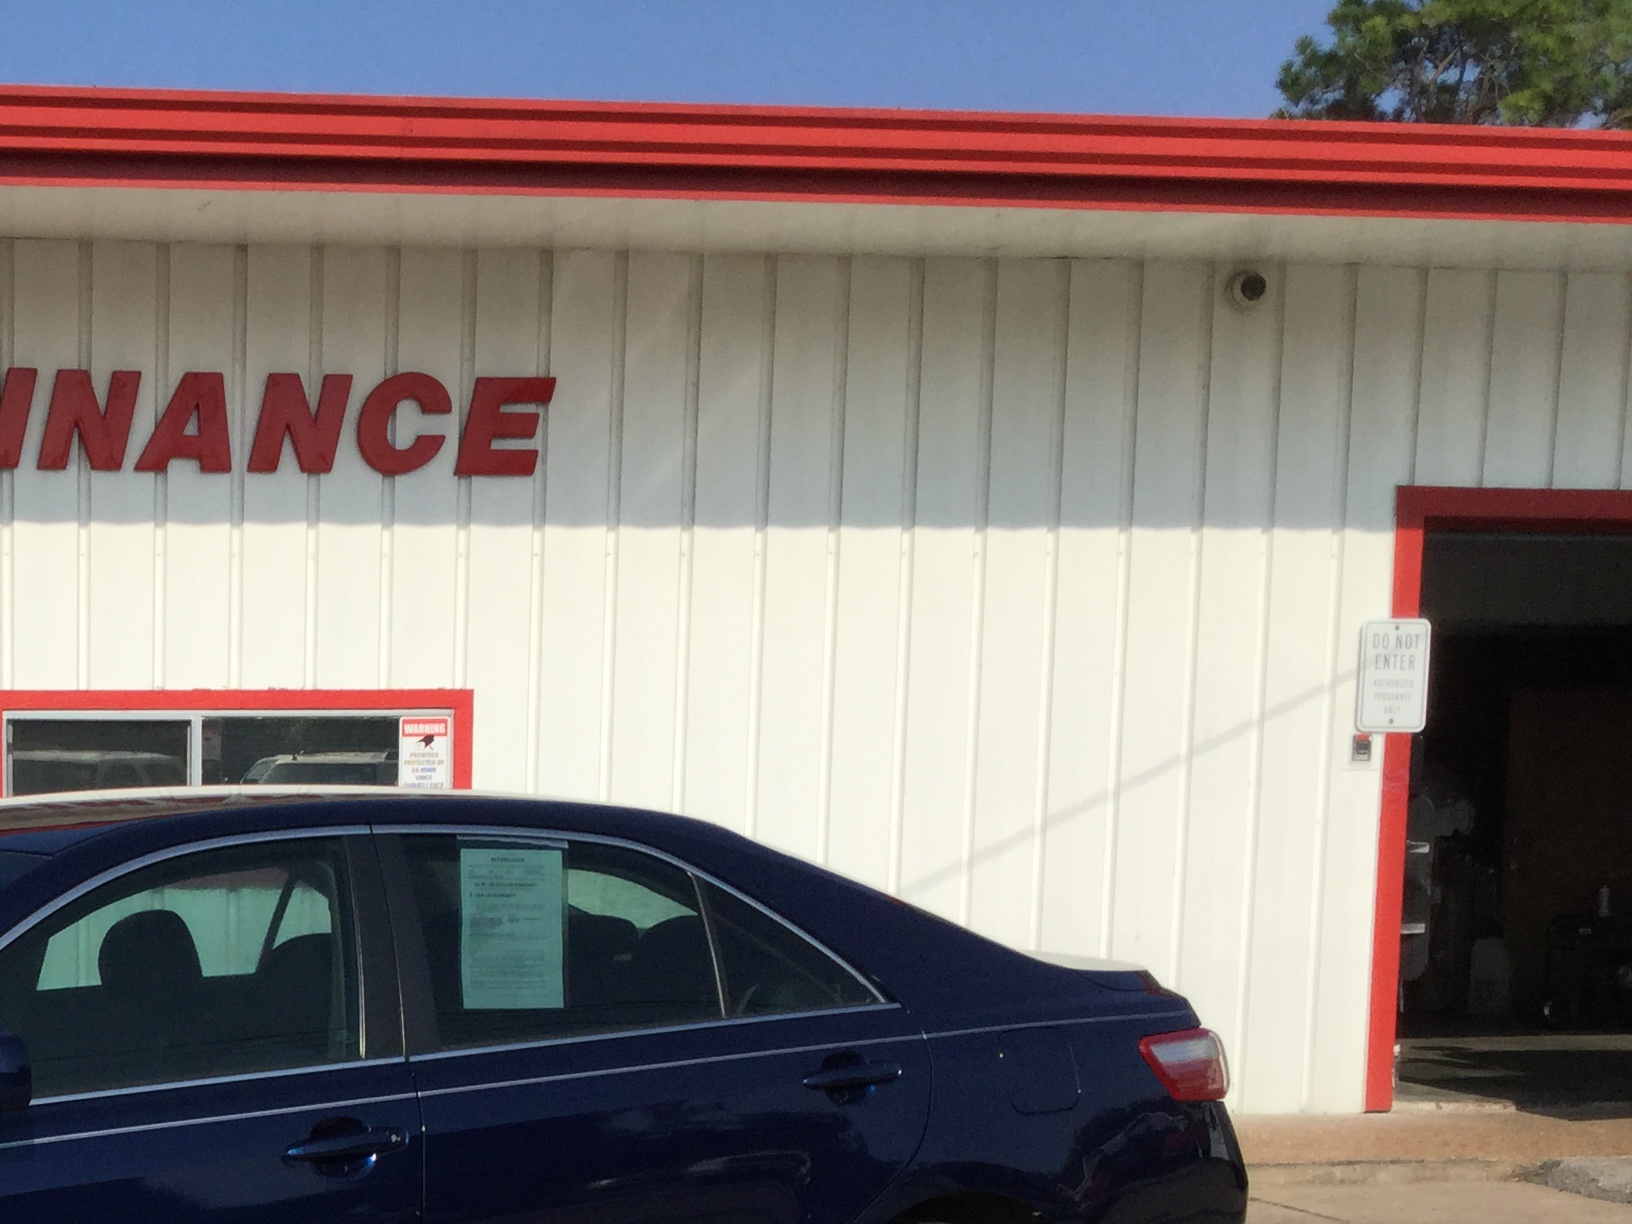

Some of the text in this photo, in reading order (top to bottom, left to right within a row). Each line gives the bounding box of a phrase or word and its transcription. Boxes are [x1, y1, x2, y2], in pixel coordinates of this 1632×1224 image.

[1373, 633, 1421, 650] DO NOT
[1375, 654, 1416, 670] ENTER
[404, 723, 446, 734] WARNING
